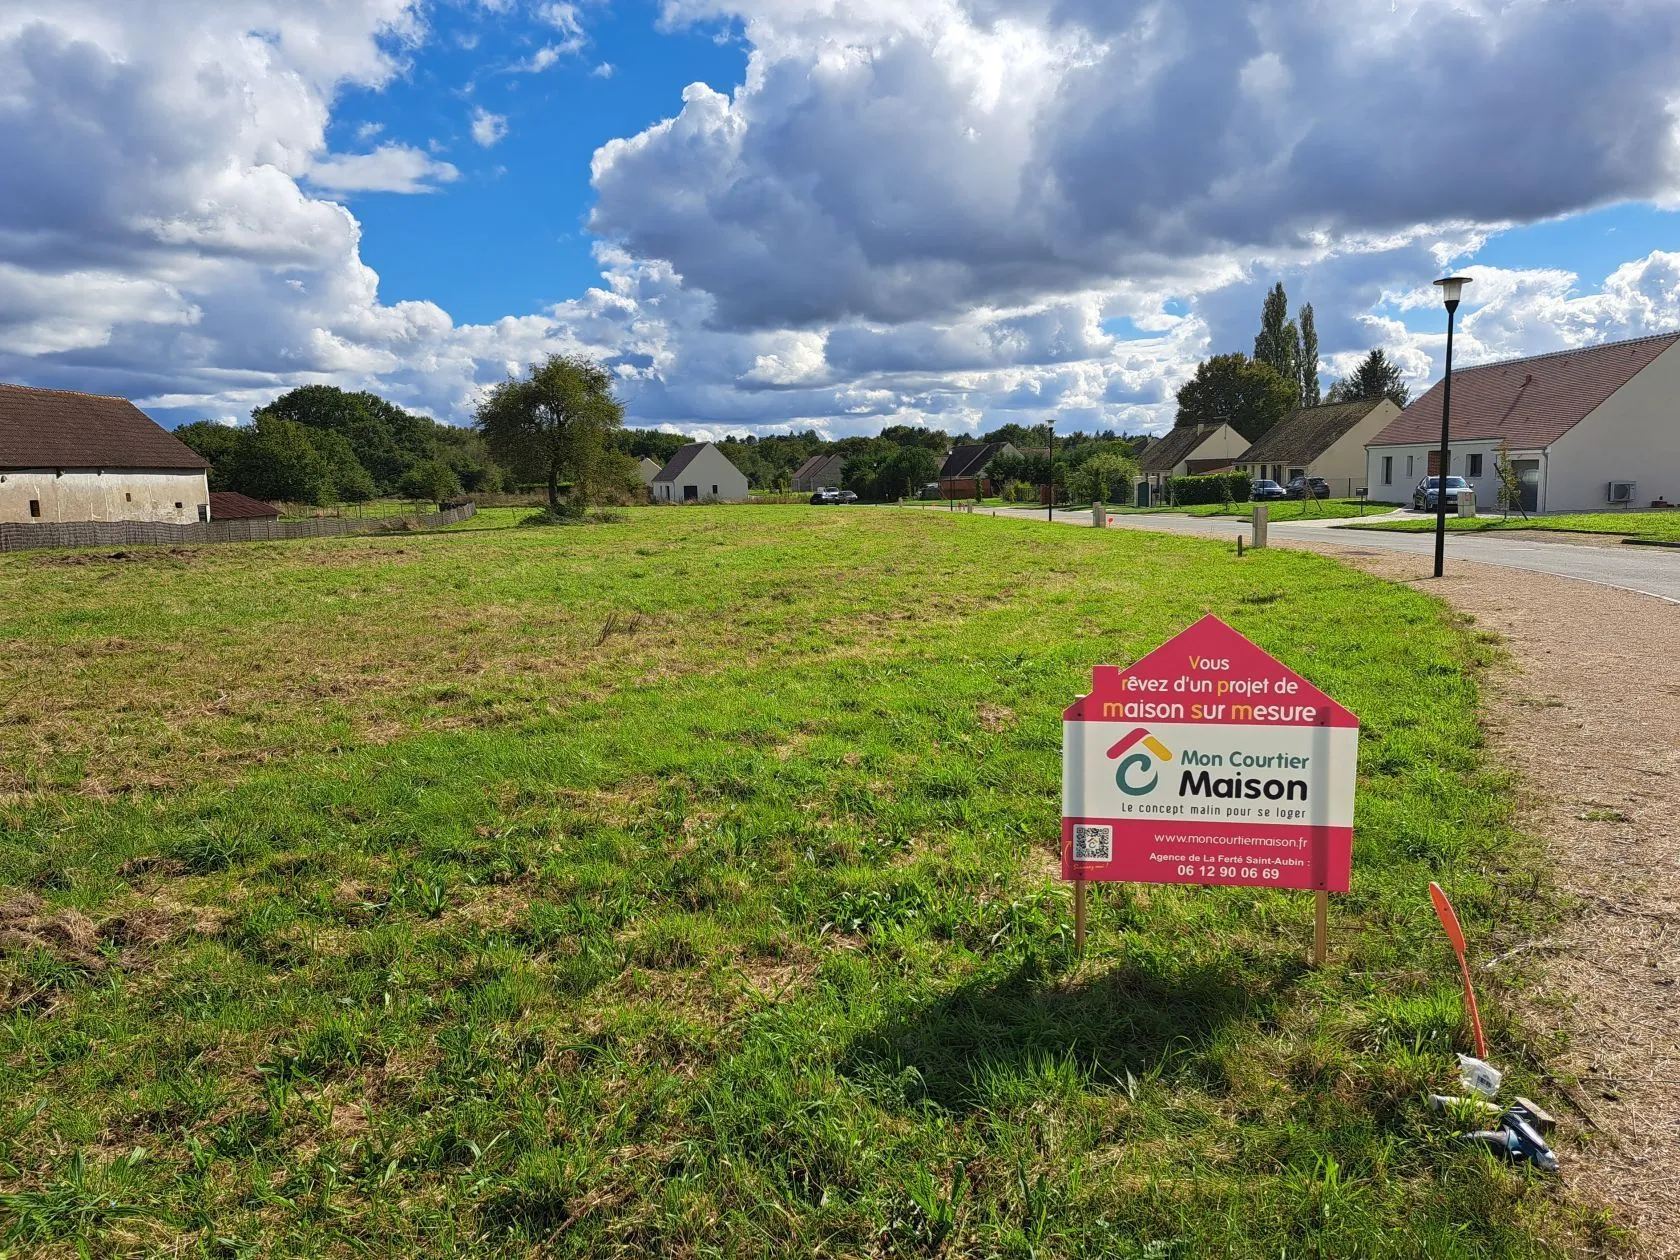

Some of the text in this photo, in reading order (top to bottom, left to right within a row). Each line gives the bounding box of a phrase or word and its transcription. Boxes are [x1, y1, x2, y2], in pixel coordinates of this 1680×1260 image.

[1188, 655, 1230, 670] Vous
[1121, 676, 1298, 697] rêvez d'un projet de
[1103, 699, 1316, 722] maison sur mesure
[1181, 750, 1309, 769] Mon Courtier
[1178, 770, 1308, 801] Maison
[1121, 802, 1306, 820] Le concept malin pour se loger
[1154, 833, 1308, 849] www.moncourtiermaison.fr
[1149, 853, 1185, 863] Agence
[1188, 854, 1200, 862] de
[1203, 854, 1215, 863] La
[1218, 854, 1243, 864] Ferté
[1245, 854, 1304, 866] Saint-Aubin
[1177, 866, 1280, 880] 06 12 90 06 69
